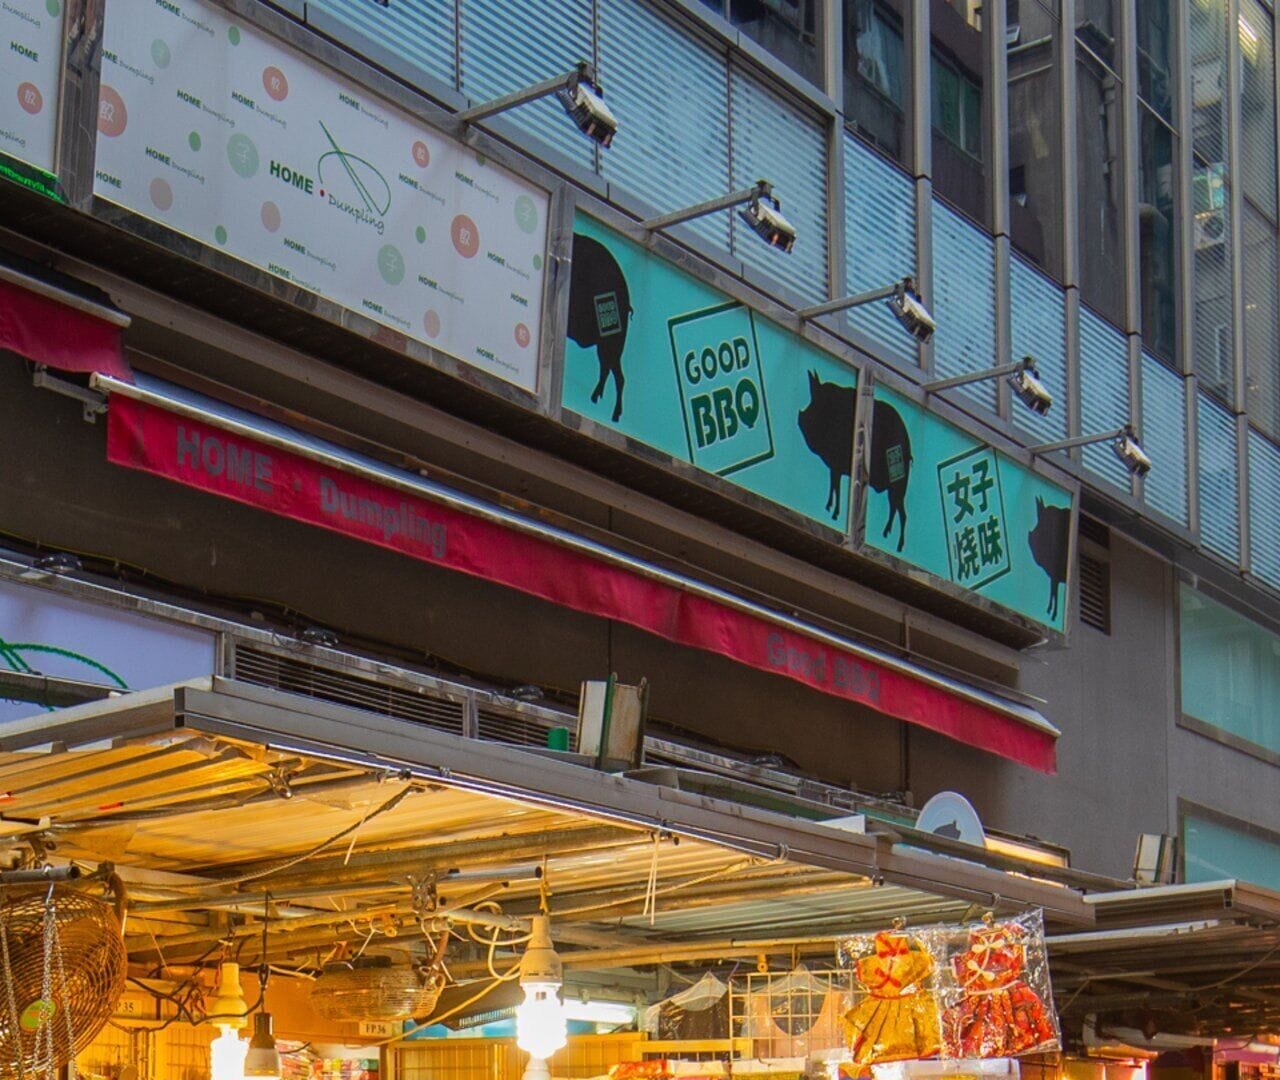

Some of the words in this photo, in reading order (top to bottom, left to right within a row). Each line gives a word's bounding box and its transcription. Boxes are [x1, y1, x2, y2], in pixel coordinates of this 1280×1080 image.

[10, 41, 39, 62] HOME
[101, 49, 118, 64] OME
[177, 89, 201, 109] HOME
[146, 147, 170, 166] HOME
[96, 169, 122, 189] HOME
[270, 160, 314, 196] HOME
[328, 194, 385, 236] Dumpling
[684, 336, 751, 385] GOOD
[690, 378, 761, 449] BBQ
[177, 426, 274, 492] HOME
[320, 476, 447, 557] Dumpling
[766, 633, 826, 682] Good
